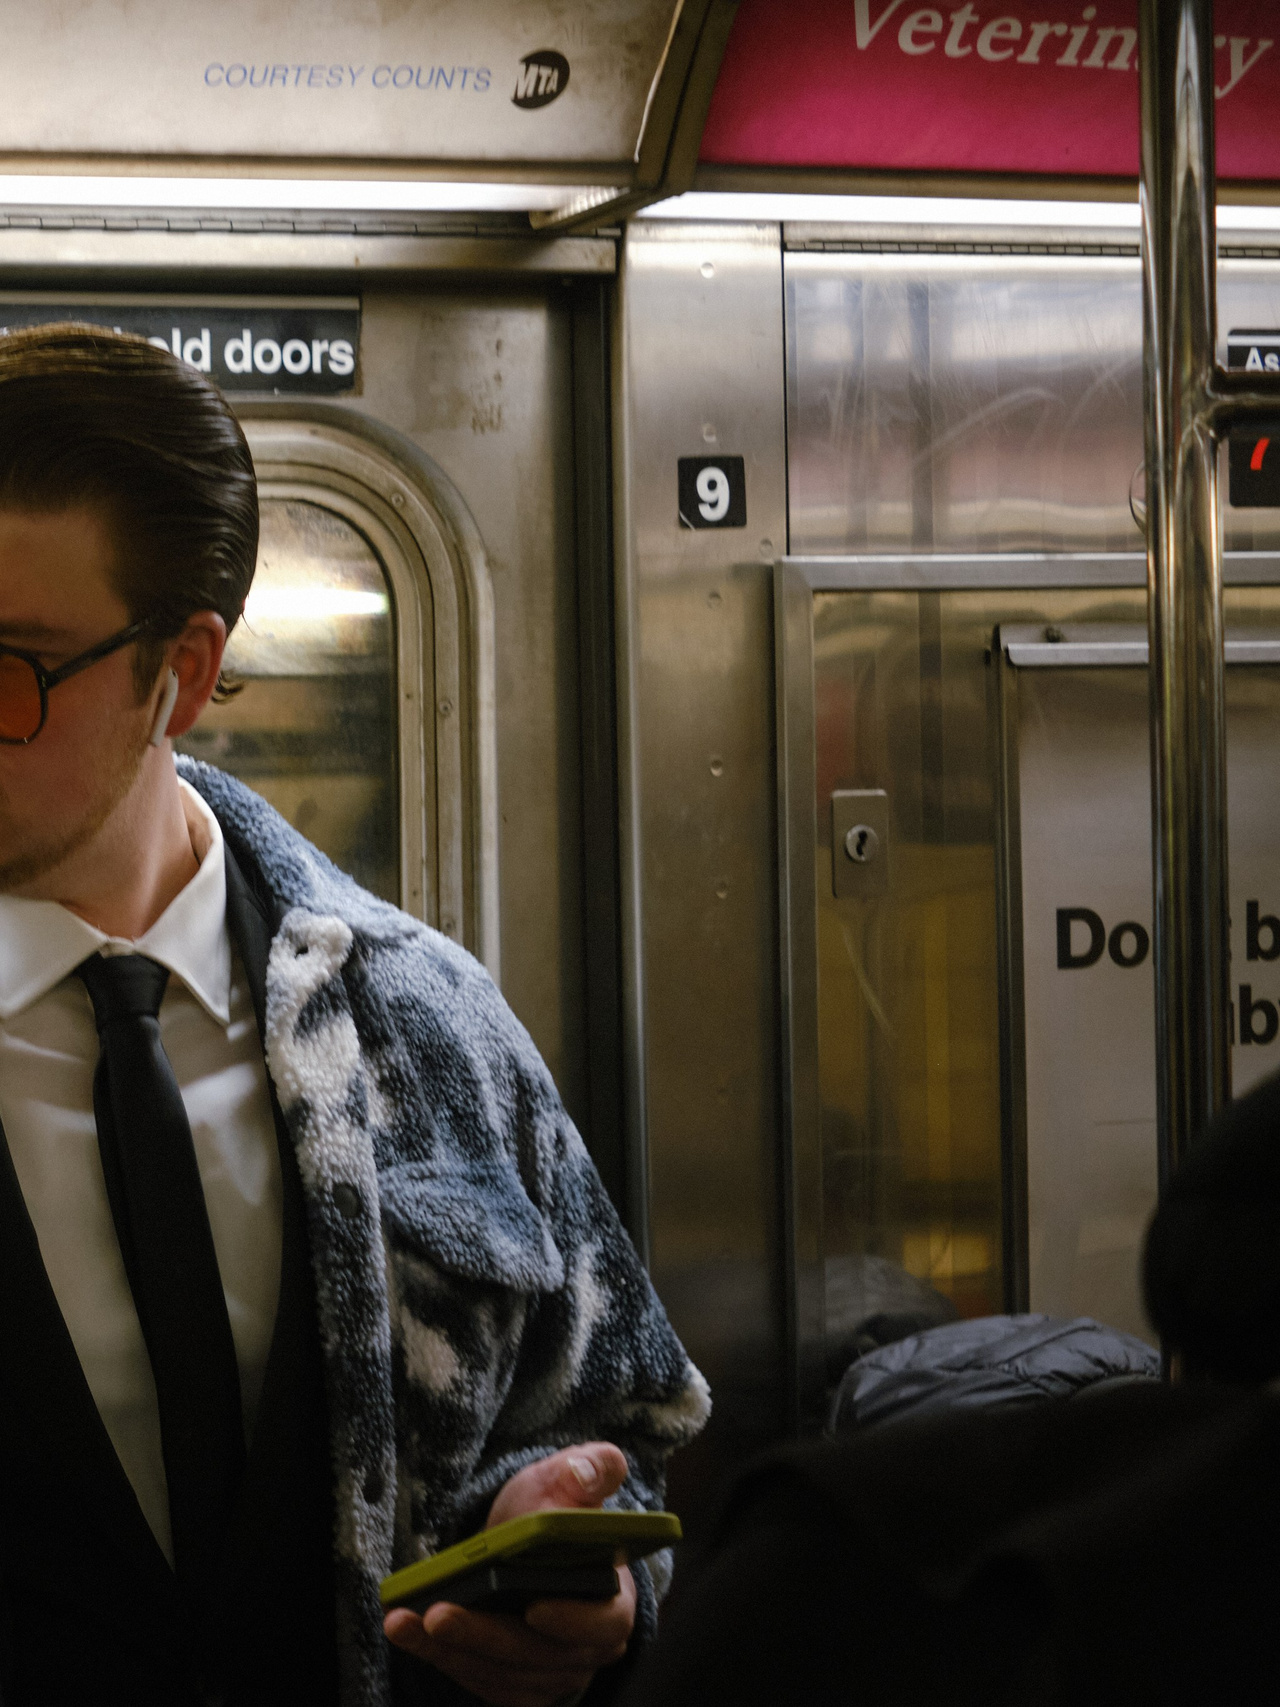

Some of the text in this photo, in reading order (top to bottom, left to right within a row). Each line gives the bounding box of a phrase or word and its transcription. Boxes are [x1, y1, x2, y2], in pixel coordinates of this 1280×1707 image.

[854, 0, 1274, 100] Veteriny
[204, 63, 492, 93] COURTESY COUNTS
[513, 62, 559, 99] MTA
[224, 328, 355, 376] doors
[696, 466, 730, 521] 9
[1056, 907, 1150, 970] Do
